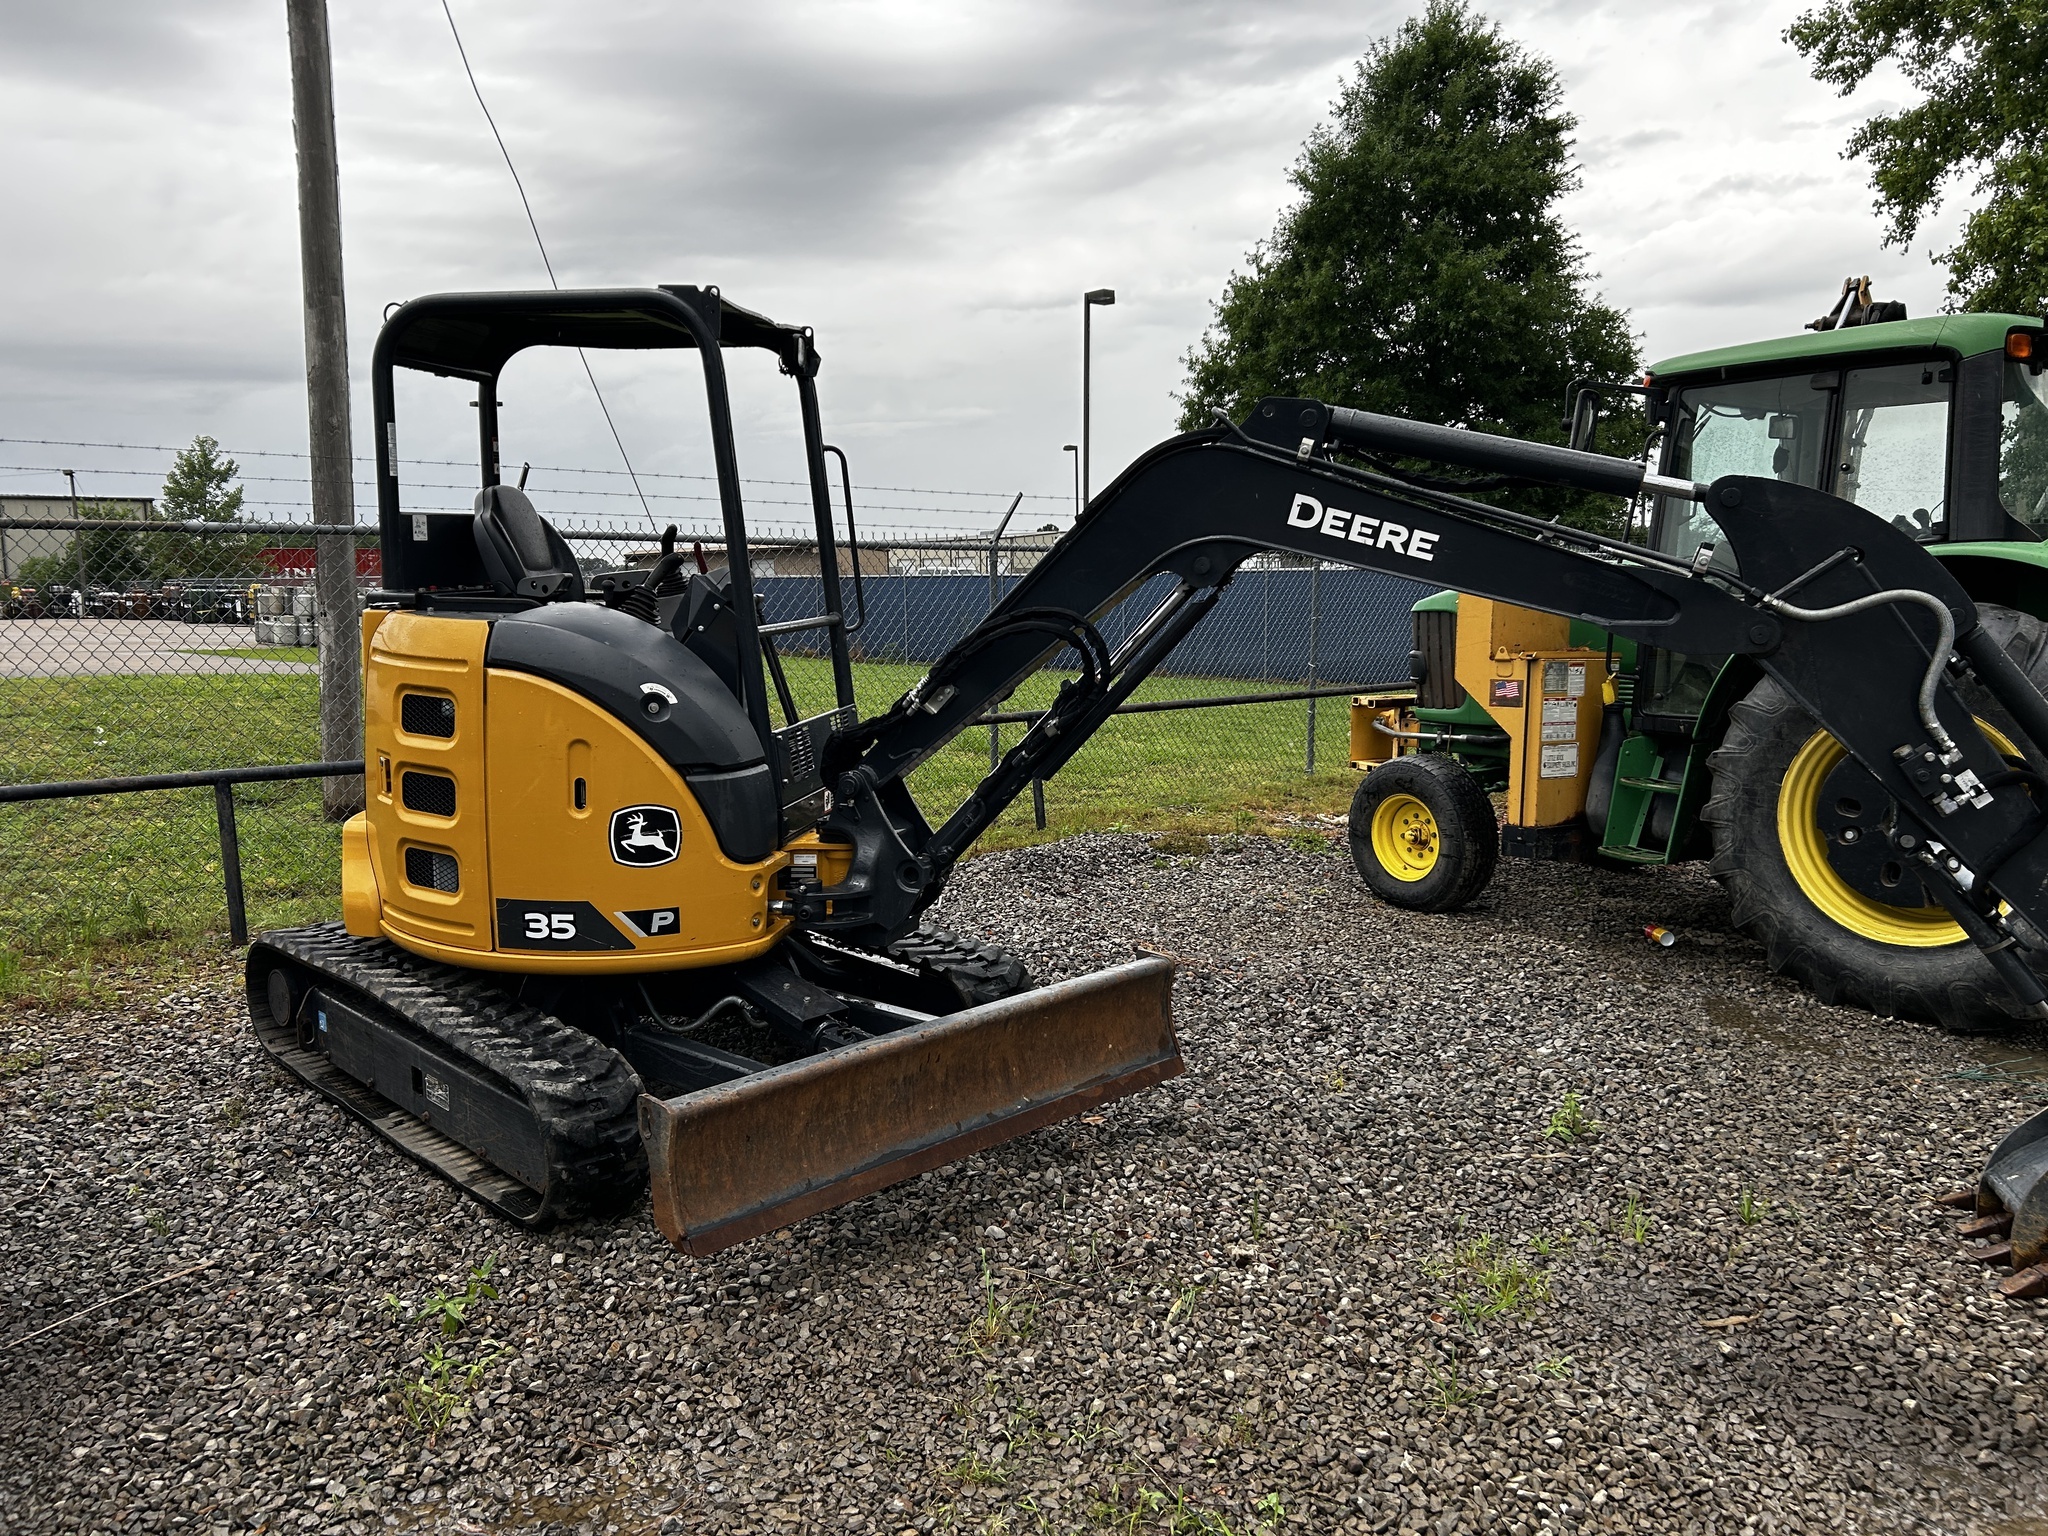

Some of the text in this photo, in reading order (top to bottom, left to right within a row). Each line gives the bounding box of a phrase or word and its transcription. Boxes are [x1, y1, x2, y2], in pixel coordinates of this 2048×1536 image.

[1287, 493, 1440, 562] DEERE
[524, 912, 577, 940] 35
[650, 911, 675, 933] P
